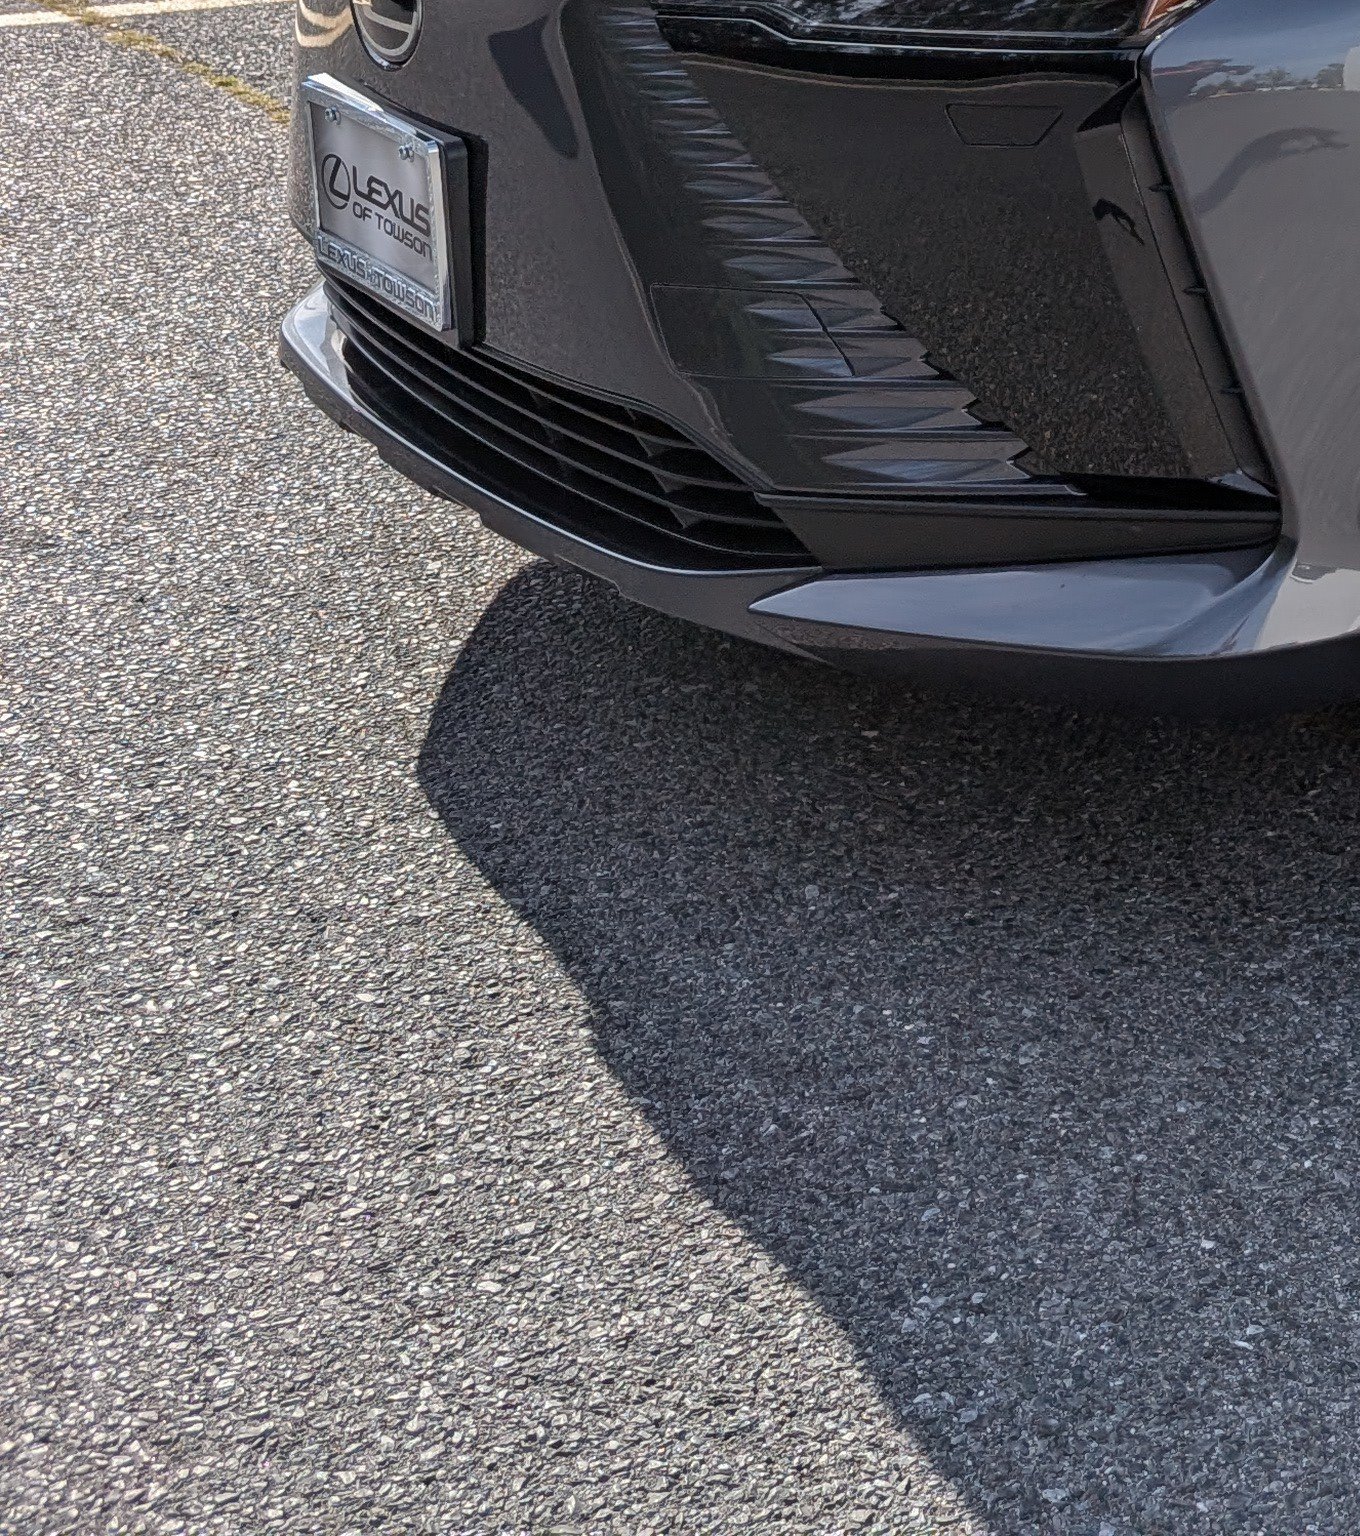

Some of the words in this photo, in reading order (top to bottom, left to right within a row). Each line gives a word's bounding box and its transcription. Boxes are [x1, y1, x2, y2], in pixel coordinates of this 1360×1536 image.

[352, 165, 431, 238] LEXUS
[352, 201, 373, 222] OF
[374, 212, 432, 260] TOWSON
[317, 235, 368, 280] LEXUS
[372, 266, 436, 321] TOWSON
